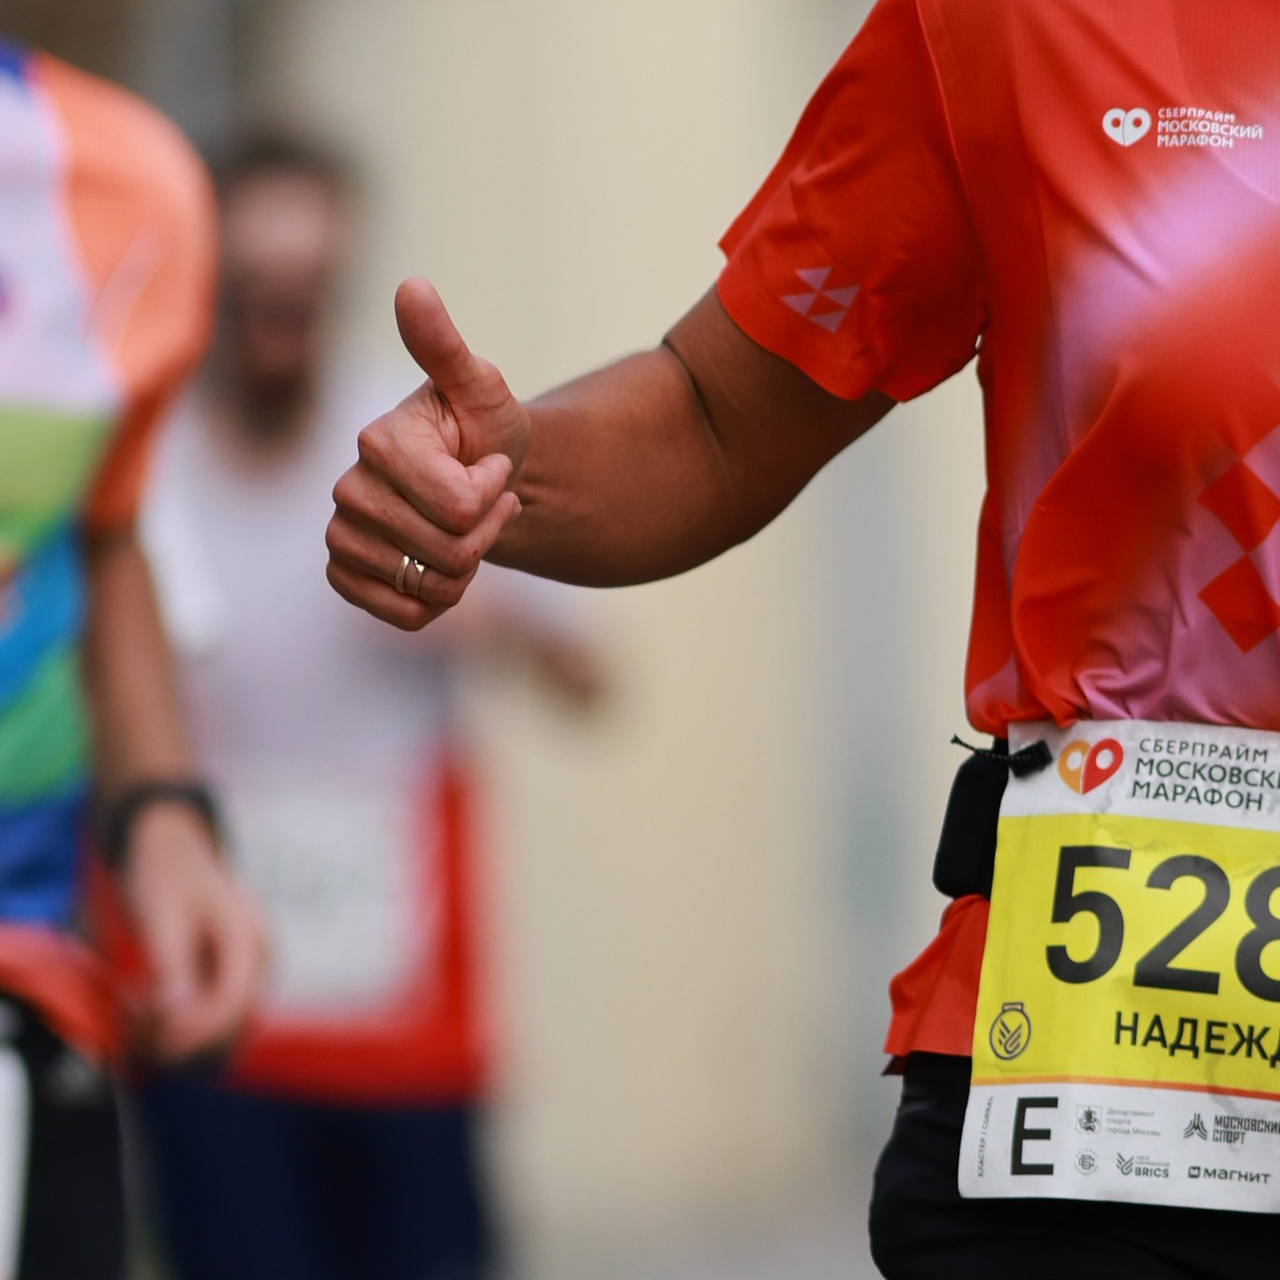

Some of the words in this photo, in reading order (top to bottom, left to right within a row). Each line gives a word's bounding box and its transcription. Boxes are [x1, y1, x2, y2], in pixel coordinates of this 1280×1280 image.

[1158, 107, 1235, 123] СБЕРПРАЙМ
[1157, 120, 1263, 139] МОСКОВСКИЙ
[1156, 134, 1233, 149] МАРАФОН
[1139, 738, 1268, 763] СБЕРПРАЙМ
[1131, 780, 1264, 811] МАРАФОН
[977, 1137, 986, 1178] КЛАСТЕР
[982, 1096, 993, 1130] CORRAL
[1212, 1129, 1247, 1145] СПОРТ
[1134, 1167, 1170, 1179] BRICS
